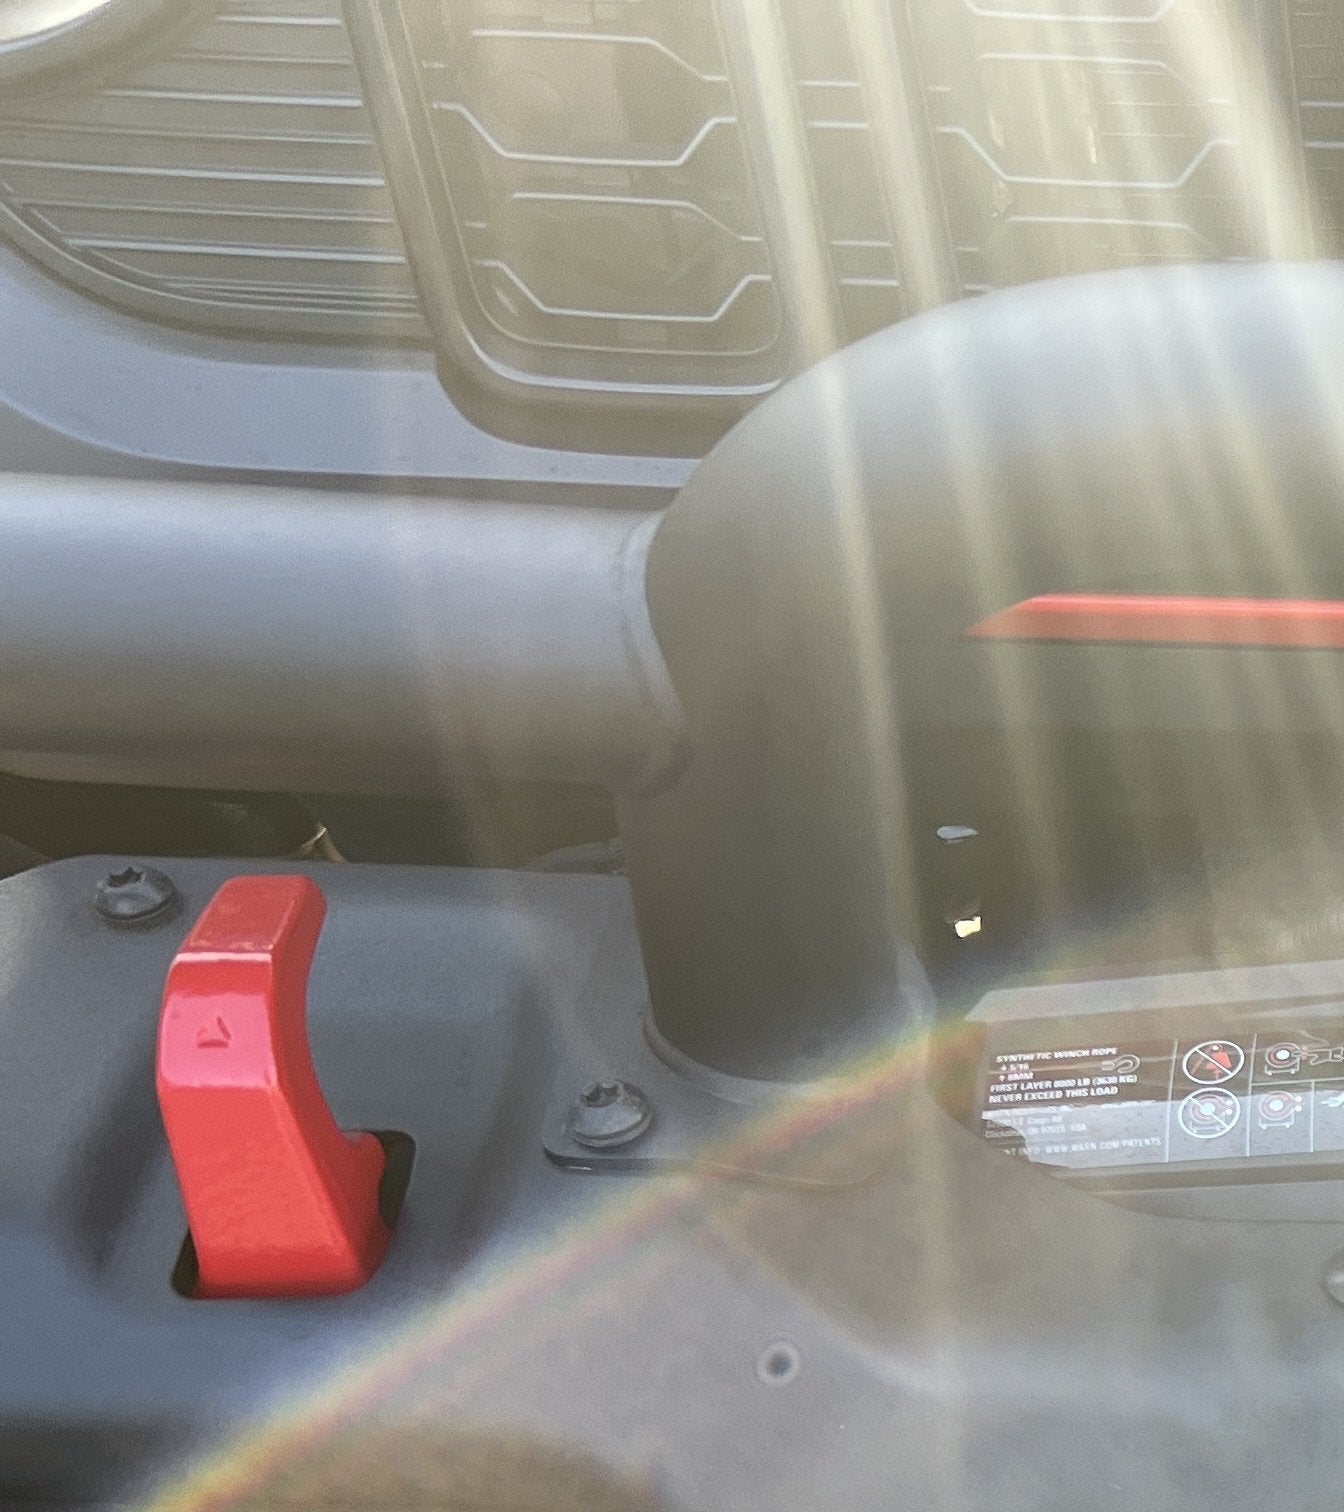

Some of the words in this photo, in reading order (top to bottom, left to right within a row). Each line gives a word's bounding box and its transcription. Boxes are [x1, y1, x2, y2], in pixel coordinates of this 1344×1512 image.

[1053, 1049, 1089, 1059] WINCH
[1091, 1047, 1118, 1056] ROPE
[990, 1083, 1018, 1093] FIRST
[1020, 1081, 1052, 1091] LAYER
[1077, 1078, 1090, 1087] LB
[1119, 1074, 1137, 1084] KG)
[989, 1093, 1022, 1103] NEVER
[1024, 1090, 1063, 1101] EXCEED
[1065, 1087, 1089, 1098] THIS
[1090, 1086, 1119, 1096] LOAD
